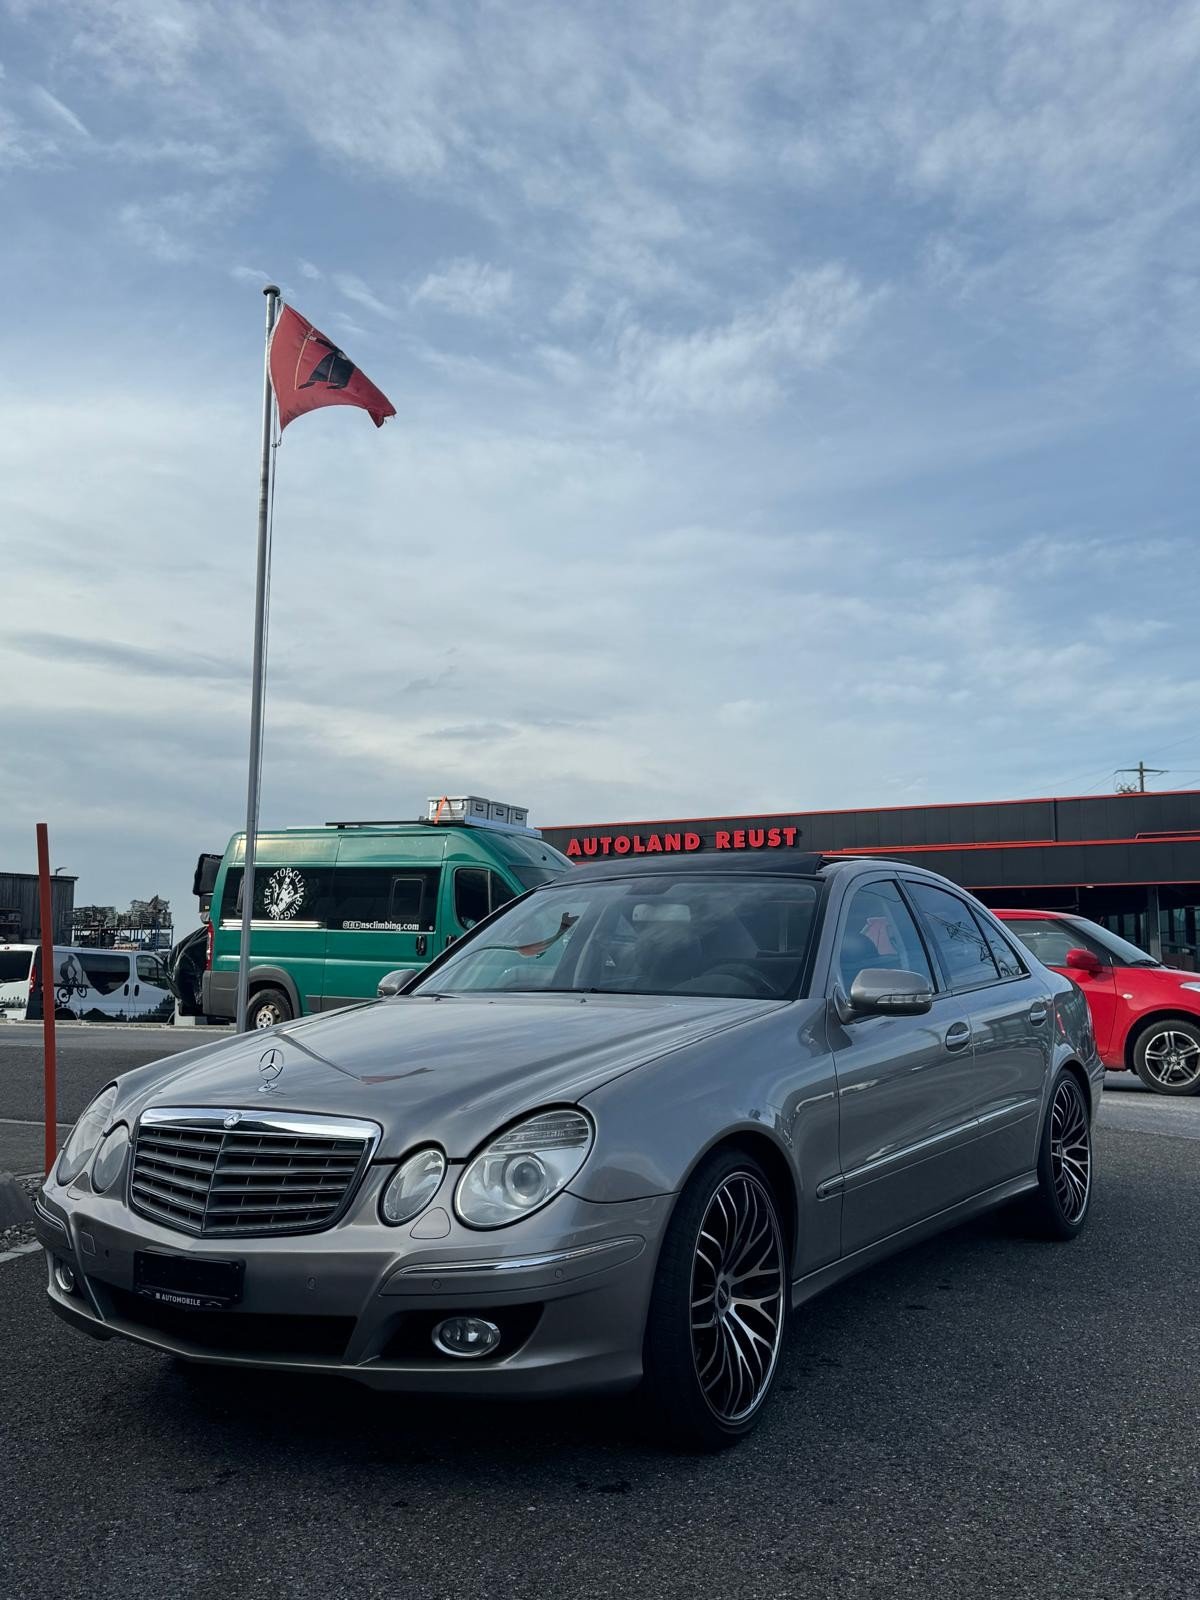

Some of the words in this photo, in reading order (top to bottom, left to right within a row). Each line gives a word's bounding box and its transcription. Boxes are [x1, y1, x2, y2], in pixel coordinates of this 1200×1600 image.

[567, 832, 700, 856] AUTOLAND
[715, 828, 797, 849] REUST
[269, 867, 292, 886] STOP
[284, 870, 304, 920] CLIMBING
[360, 920, 420, 932] nsclimbing.com
[161, 1293, 201, 1306] AUTOMOBILE
